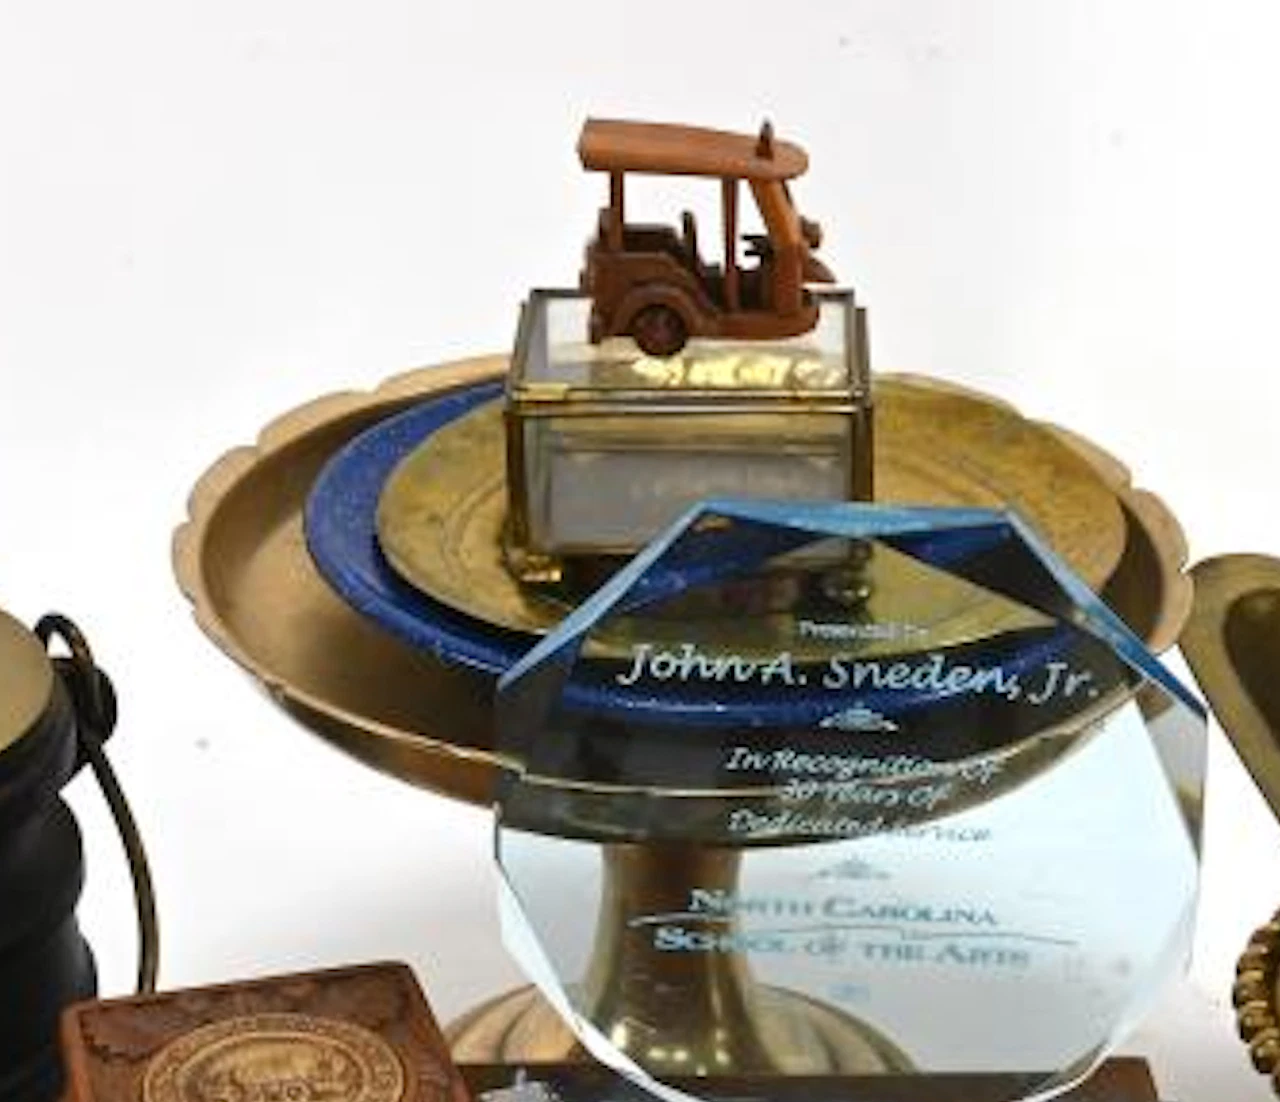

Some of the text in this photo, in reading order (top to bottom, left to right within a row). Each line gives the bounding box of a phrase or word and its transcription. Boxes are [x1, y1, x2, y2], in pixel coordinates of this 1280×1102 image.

[618, 643, 1100, 703] John A. Sneden, Jr.
[726, 747, 764, 770] In
[770, 749, 958, 780] Recognition
[726, 808, 882, 834] Dedicated
[821, 894, 999, 926] CAROLINA
